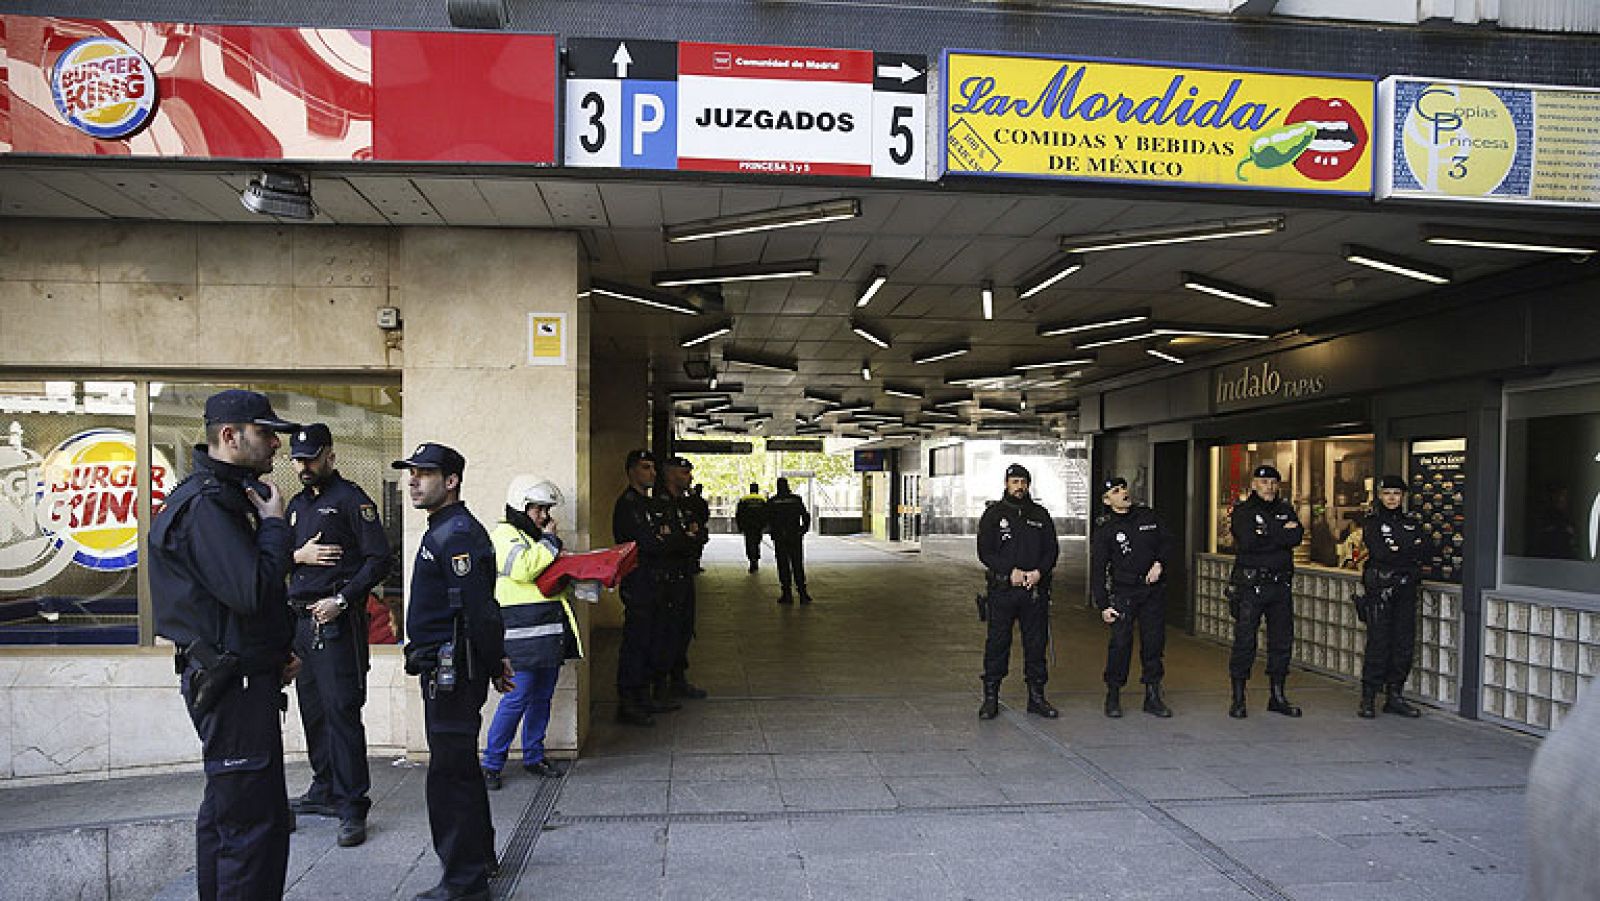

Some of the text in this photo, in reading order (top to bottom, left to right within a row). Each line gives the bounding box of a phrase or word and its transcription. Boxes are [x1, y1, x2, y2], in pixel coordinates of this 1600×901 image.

[62, 57, 142, 89] BURGER
[735, 57, 790, 68] Comunidad
[791, 60, 804, 69] de
[805, 60, 840, 70] Madrid
[65, 75, 145, 112] KING
[952, 64, 1282, 131] La Mordida
[579, 91, 607, 153] 3
[632, 93, 665, 156] P
[695, 107, 855, 133] JUZGADOS
[888, 105, 914, 166] 5
[993, 128, 1235, 157] COMIDAS Y BEBIDAS
[739, 162, 787, 172] PRINCESA
[1049, 154, 1184, 177] DE MÉXICO
[1447, 155, 1469, 180] 3
[1216, 361, 1324, 403] Indalo TAPAS
